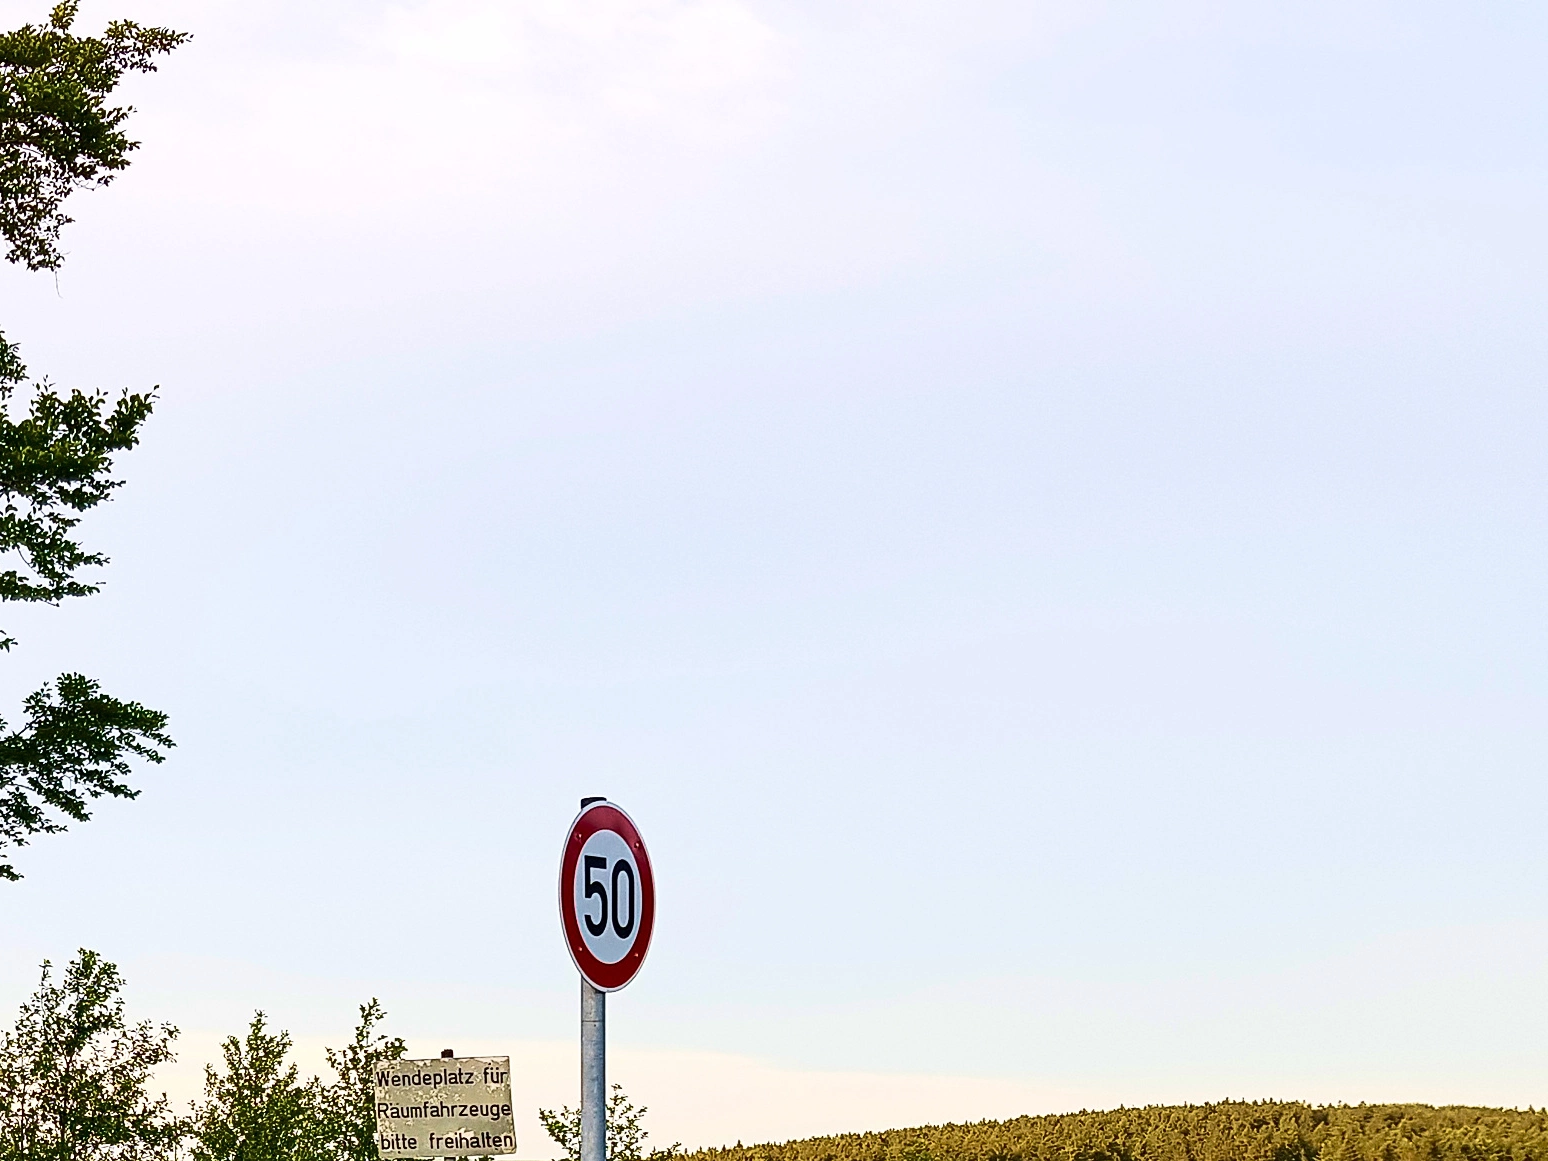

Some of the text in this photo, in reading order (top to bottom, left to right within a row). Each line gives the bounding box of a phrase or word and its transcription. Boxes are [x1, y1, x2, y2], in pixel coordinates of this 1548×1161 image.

[584, 855, 635, 939] 50
[375, 1066, 508, 1089] Wendeplatz für
[380, 1131, 513, 1150] bitte freihalten
